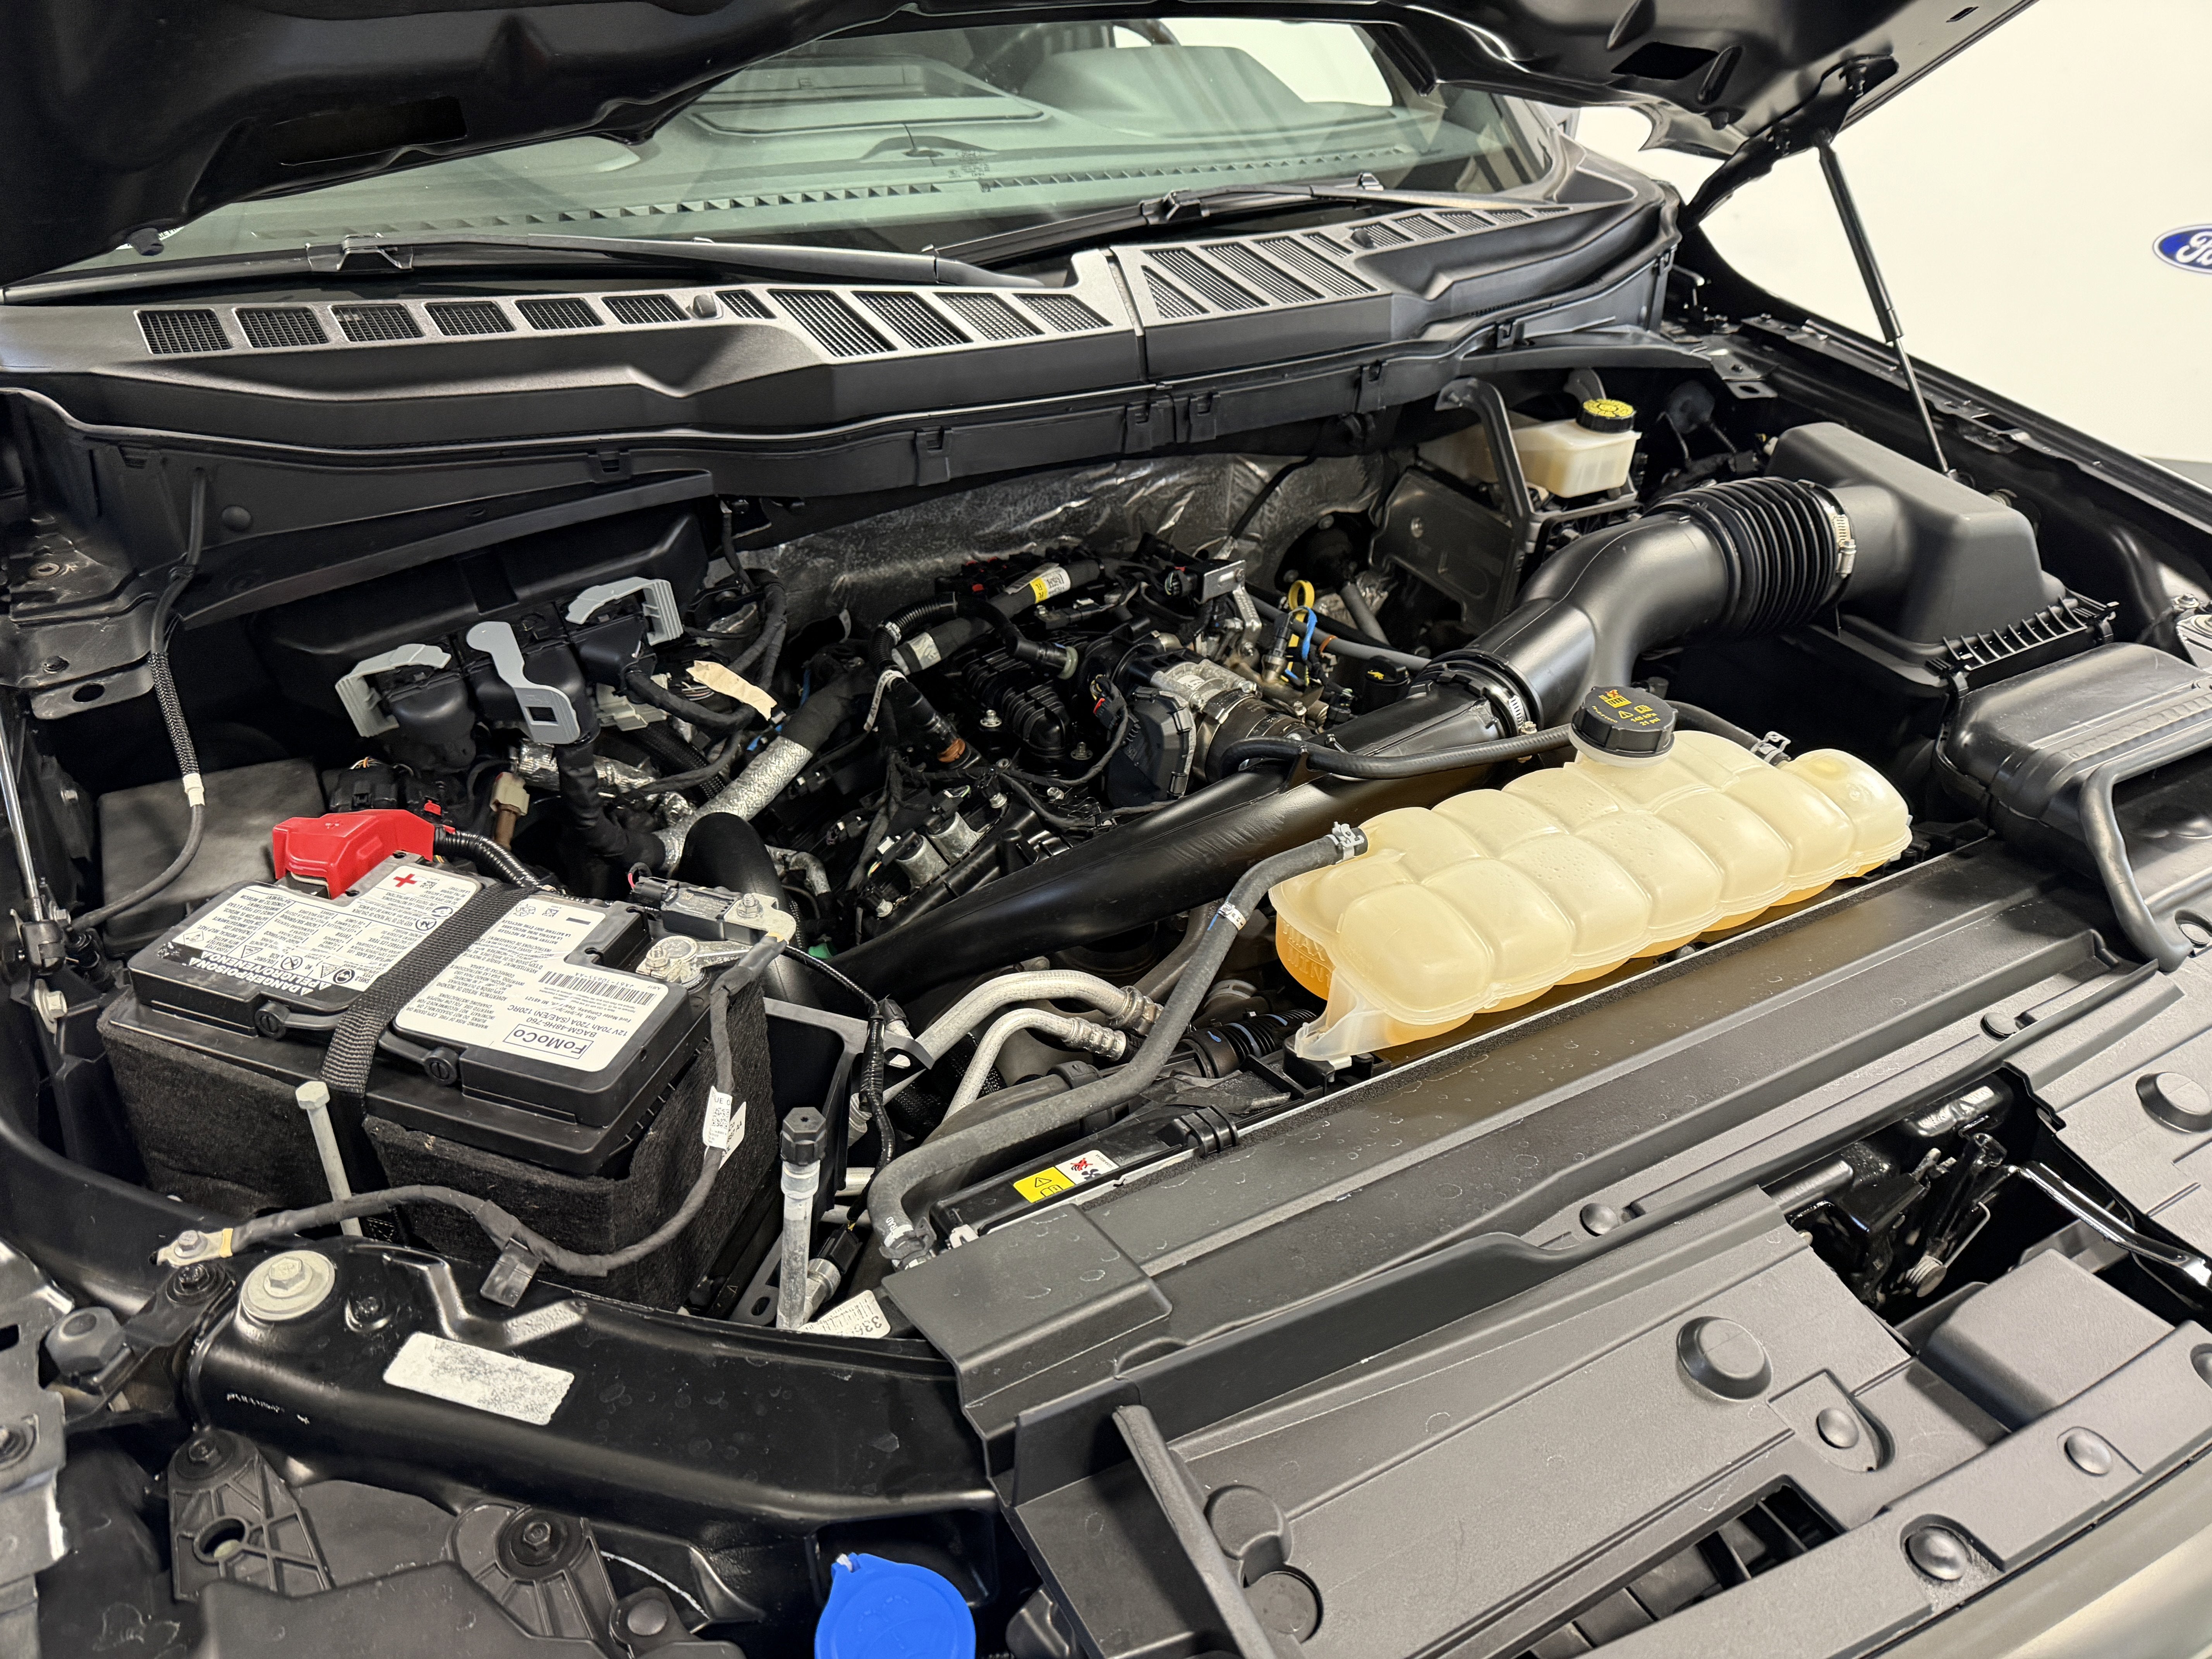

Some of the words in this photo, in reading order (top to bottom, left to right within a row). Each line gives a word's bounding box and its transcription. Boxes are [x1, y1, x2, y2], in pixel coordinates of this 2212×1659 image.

[501, 924, 527, 933] RECICLARSE
[219, 930, 238, 938] MEDICAL
[206, 939, 235, 949] IMMEDIATELY
[521, 943, 552, 952] INSTRUCTIONS
[254, 956, 276, 964] SULFURIC
[209, 953, 320, 988] PELIGRO/VENENO
[489, 969, 515, 978] CORRECTAS
[196, 960, 301, 993] DANGER/POISON
[426, 1001, 460, 1012] RECOMMENDED
[469, 1000, 492, 1009] CHARGING
[412, 1008, 438, 1017] EXPLOSION
[423, 1005, 454, 1015] DISASSEMBLE
[507, 1005, 532, 1014] 120RC
[577, 1007, 602, 1017] Company,
[533, 1010, 570, 1023] (SAE/EN)
[526, 1017, 597, 1037] BAGM-48H6-760
[570, 1019, 591, 1028] 720A
[591, 1024, 612, 1033] 70Ah
[513, 1029, 587, 1054] FoMoCo
